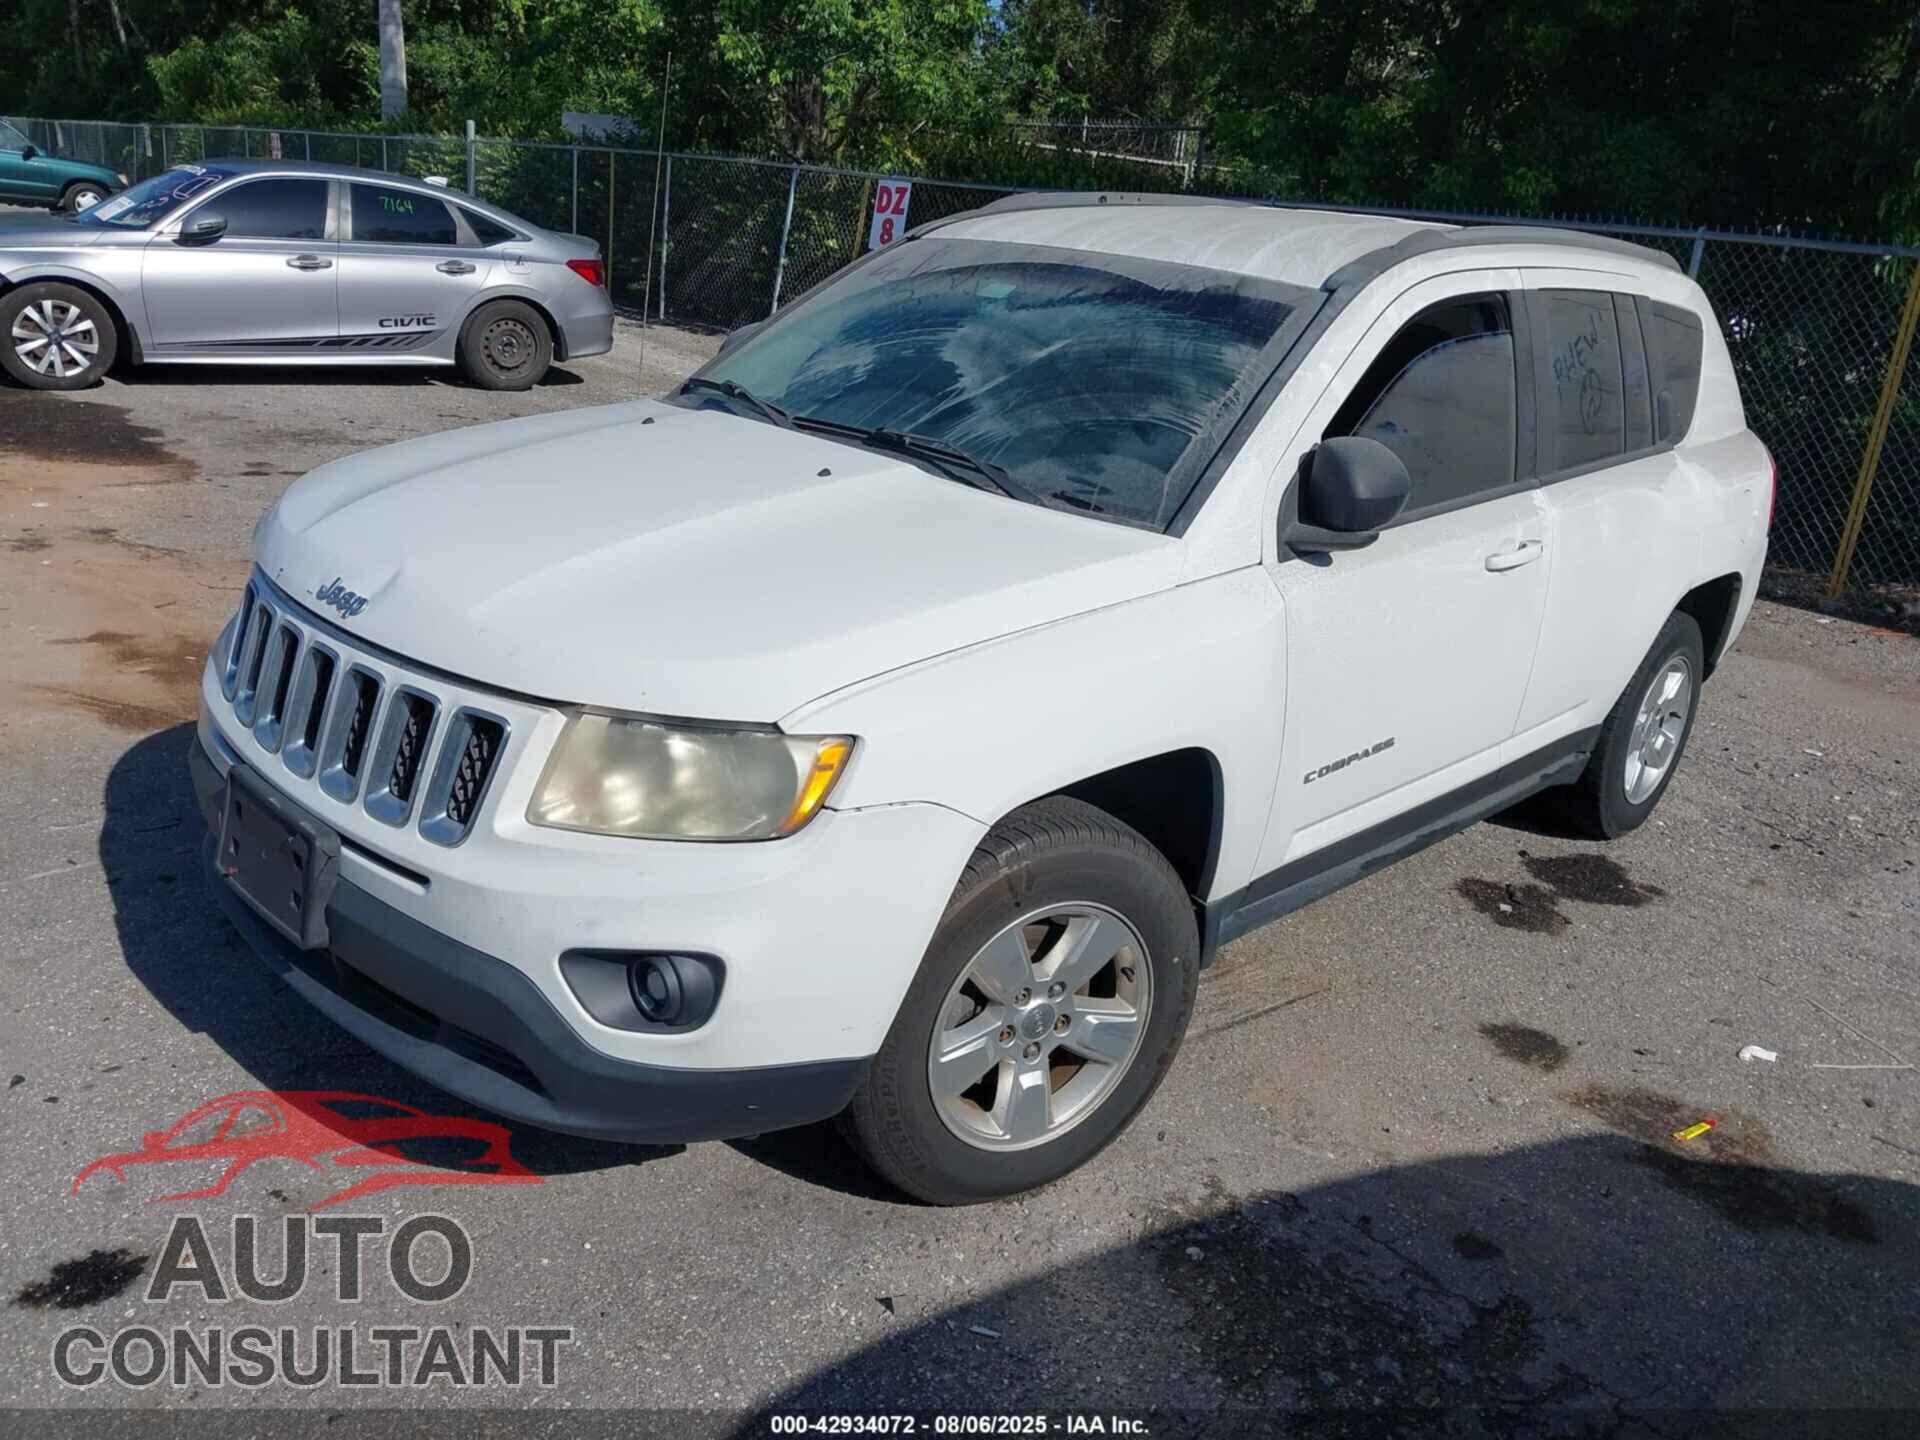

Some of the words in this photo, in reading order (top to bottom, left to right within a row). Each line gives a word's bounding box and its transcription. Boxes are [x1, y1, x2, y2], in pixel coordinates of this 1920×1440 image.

[876, 186, 908, 215] DZ
[880, 218, 894, 244] 8
[379, 316, 436, 328] CIVIC
[316, 577, 369, 619] Jeep
[1303, 737, 1395, 784] COMPASS
